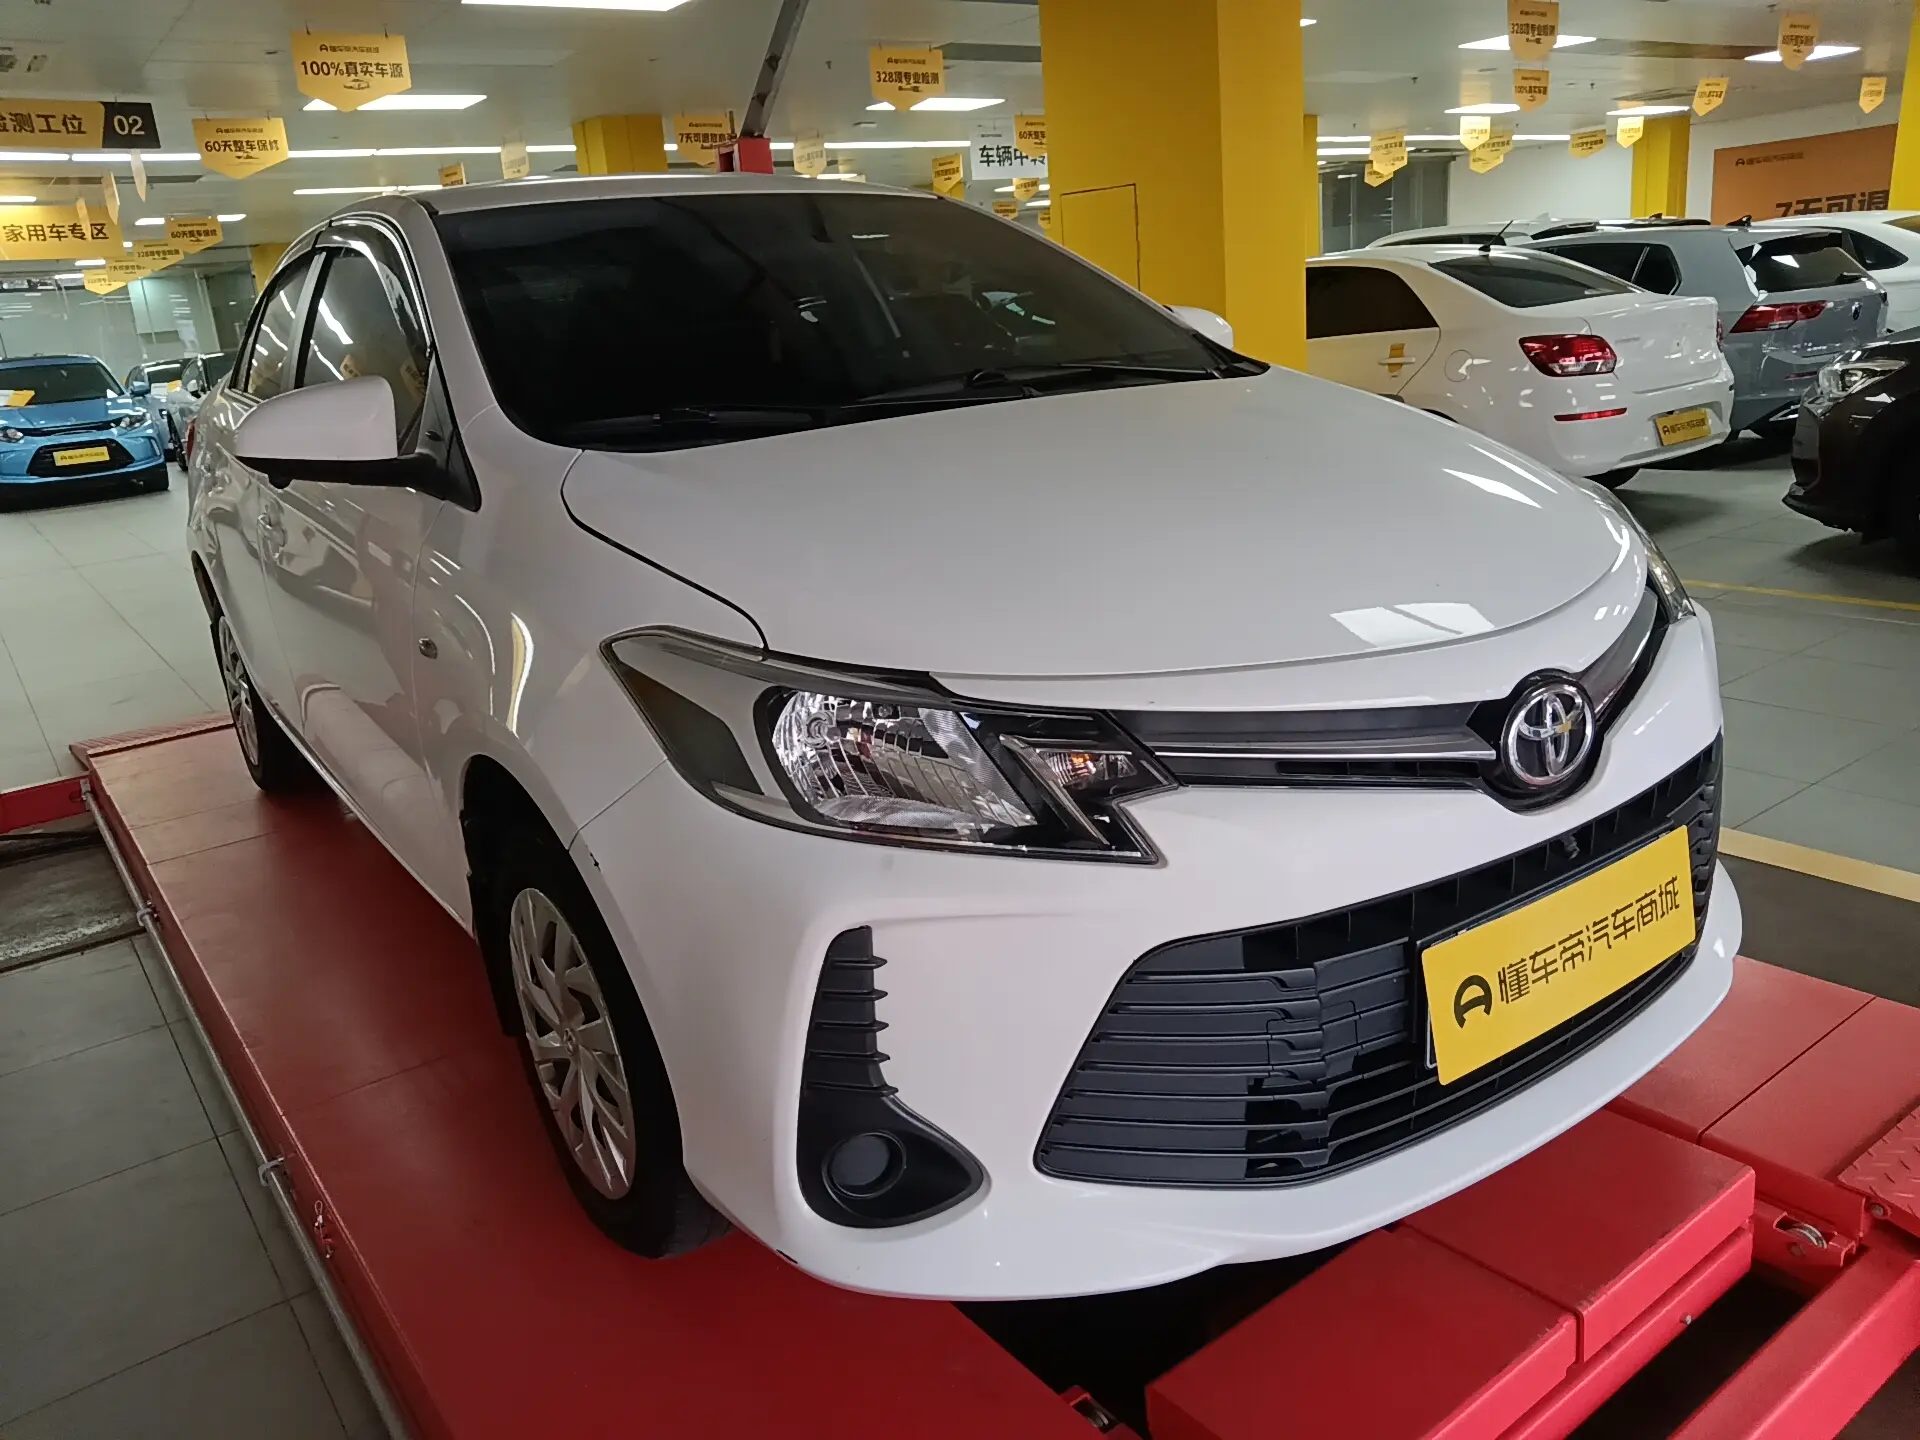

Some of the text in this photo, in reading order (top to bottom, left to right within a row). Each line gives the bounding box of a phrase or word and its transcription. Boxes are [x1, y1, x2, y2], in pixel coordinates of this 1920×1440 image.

[301, 60, 404, 78] 100%真实车源
[876, 71, 940, 85] 328项专业检测
[113, 115, 145, 135] 02
[204, 140, 280, 153] 60天整车保修
[2, 223, 110, 242] 家用车专区
[1497, 876, 1680, 1004] 懂车帝汽车商城
